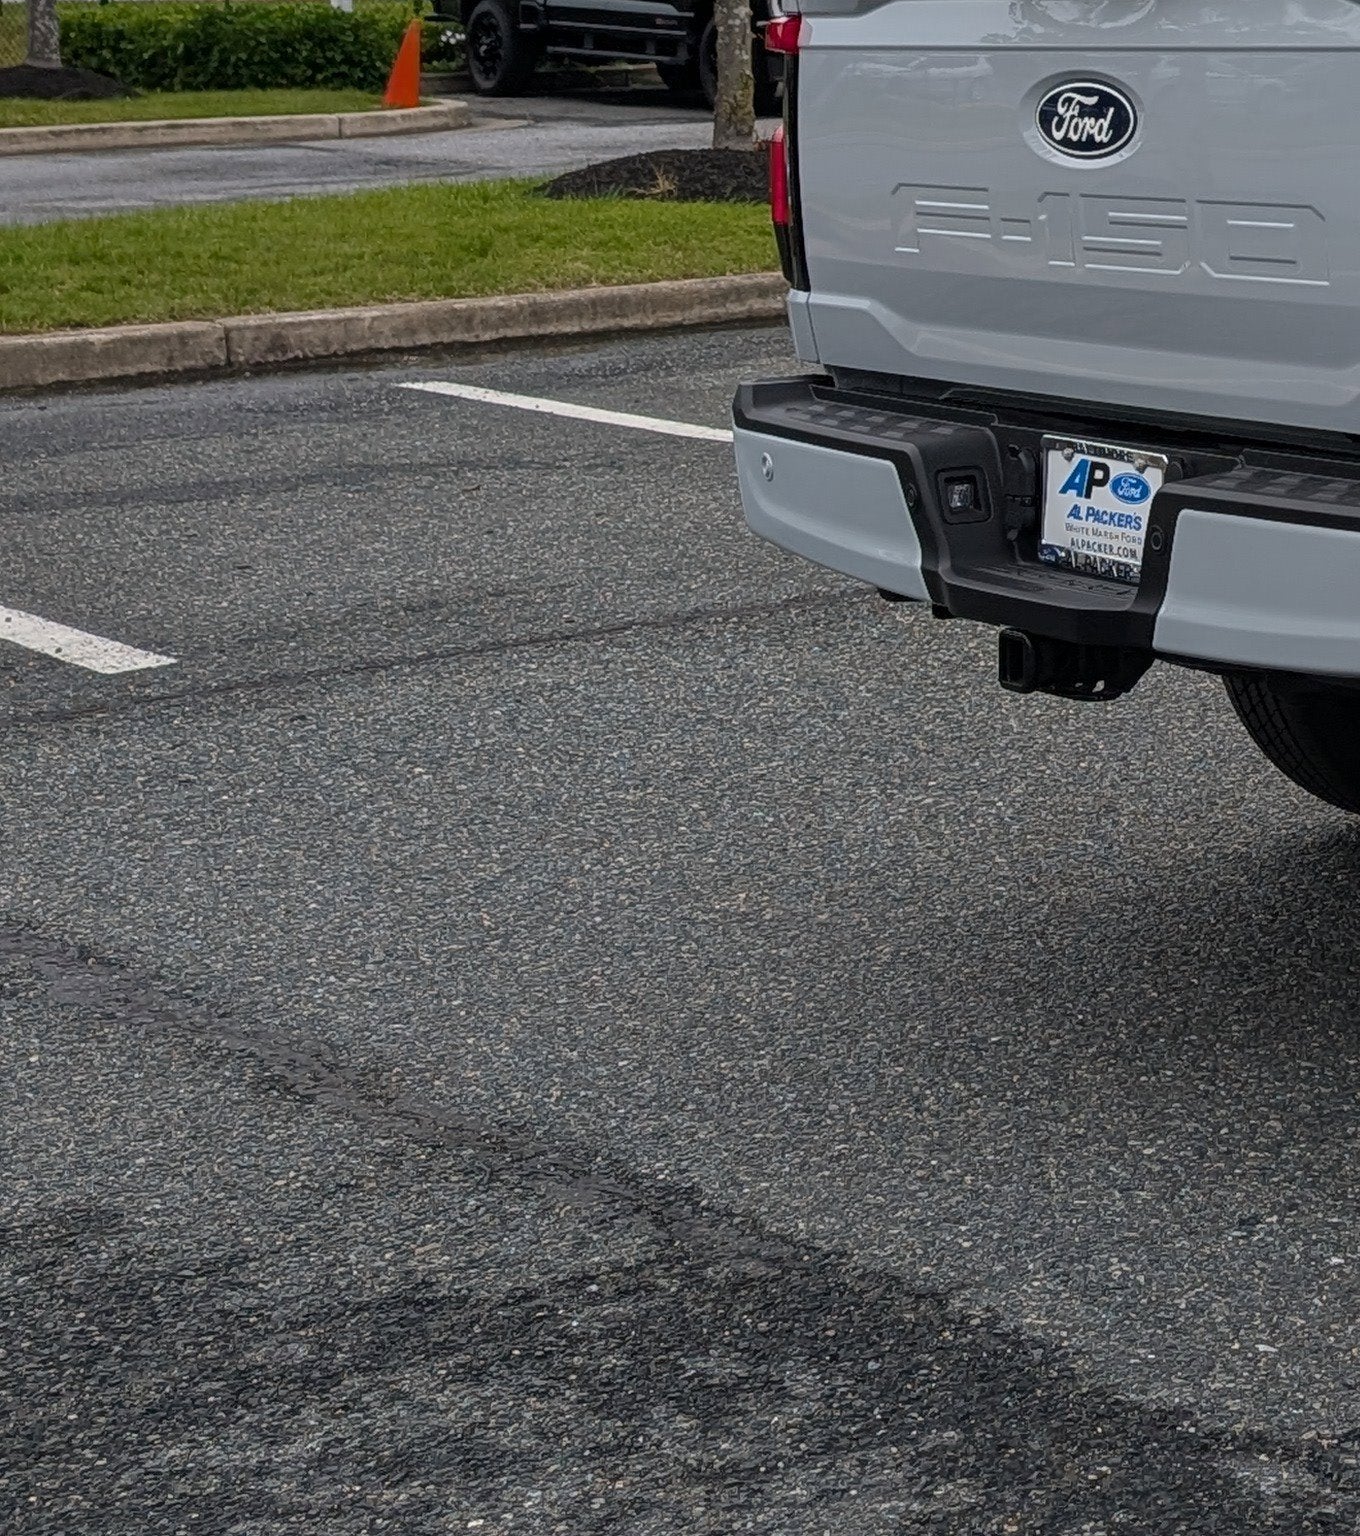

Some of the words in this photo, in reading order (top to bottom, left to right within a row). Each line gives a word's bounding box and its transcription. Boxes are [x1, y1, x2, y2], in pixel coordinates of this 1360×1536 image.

[1051, 92, 1115, 143] Ford
[890, 182, 1330, 286] F-150
[1058, 458, 1111, 500] AP
[1117, 476, 1143, 499] Ford
[1066, 504, 1084, 521] AL
[1085, 506, 1142, 531] PACKER'S
